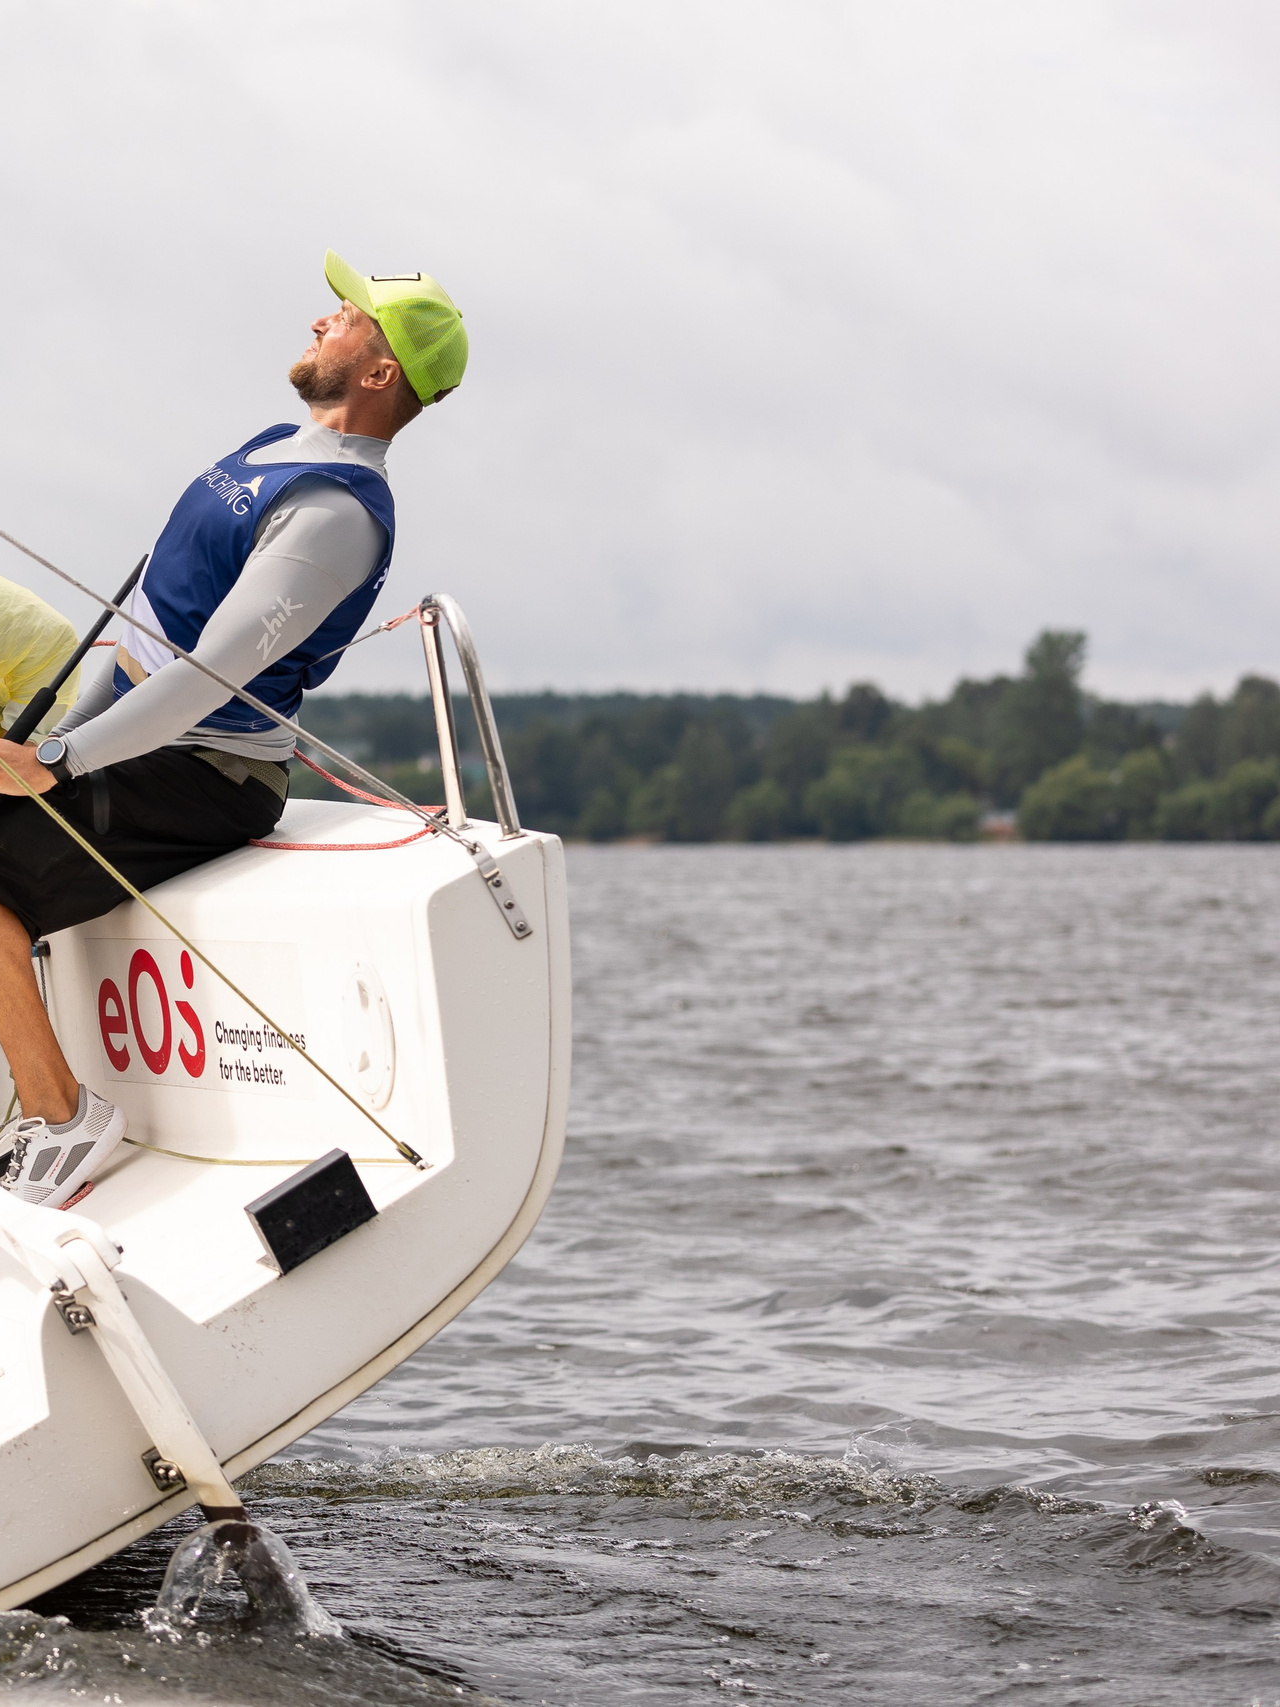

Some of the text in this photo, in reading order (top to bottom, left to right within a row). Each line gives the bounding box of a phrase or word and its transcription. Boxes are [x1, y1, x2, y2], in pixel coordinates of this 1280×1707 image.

[215, 1021, 262, 1052] Changing
[219, 1057, 286, 1086] for the better.
